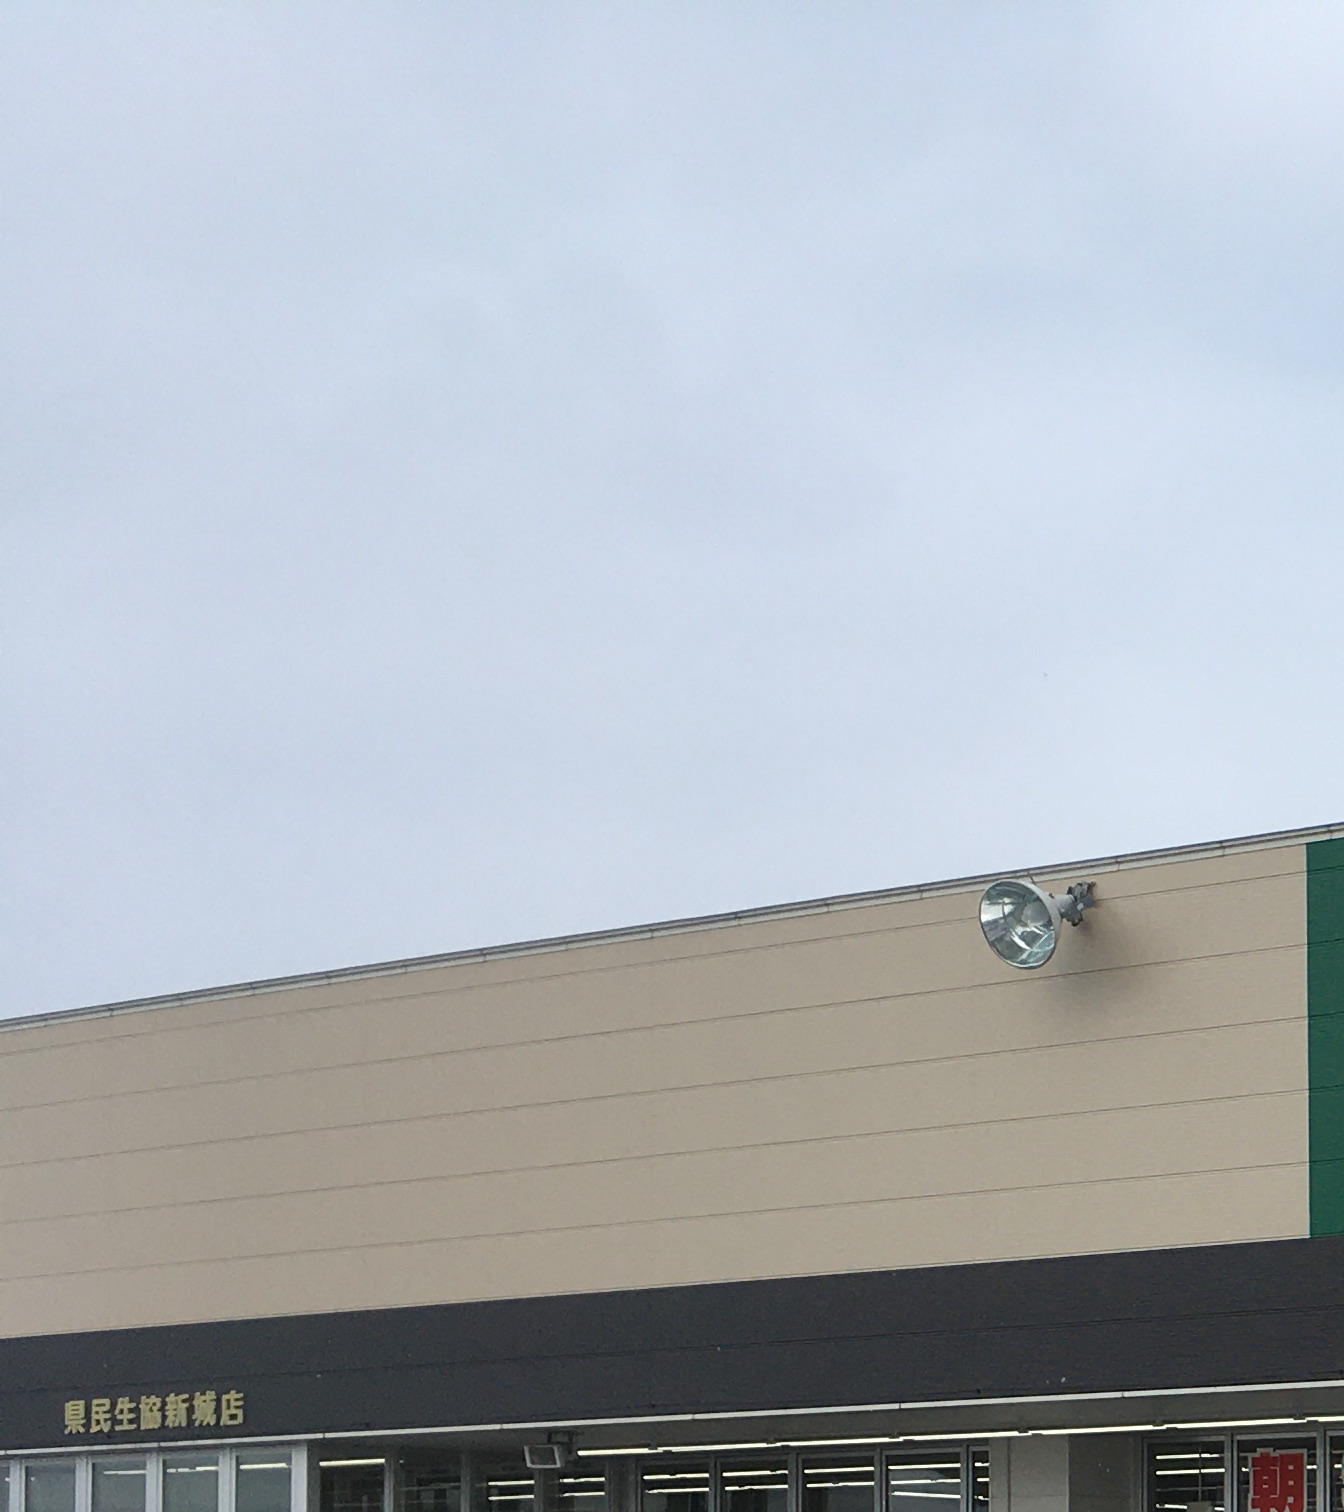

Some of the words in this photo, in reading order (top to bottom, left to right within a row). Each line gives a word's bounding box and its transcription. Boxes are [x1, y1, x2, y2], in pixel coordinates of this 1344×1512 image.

[64, 1390, 244, 1434] 県民生協新城店
